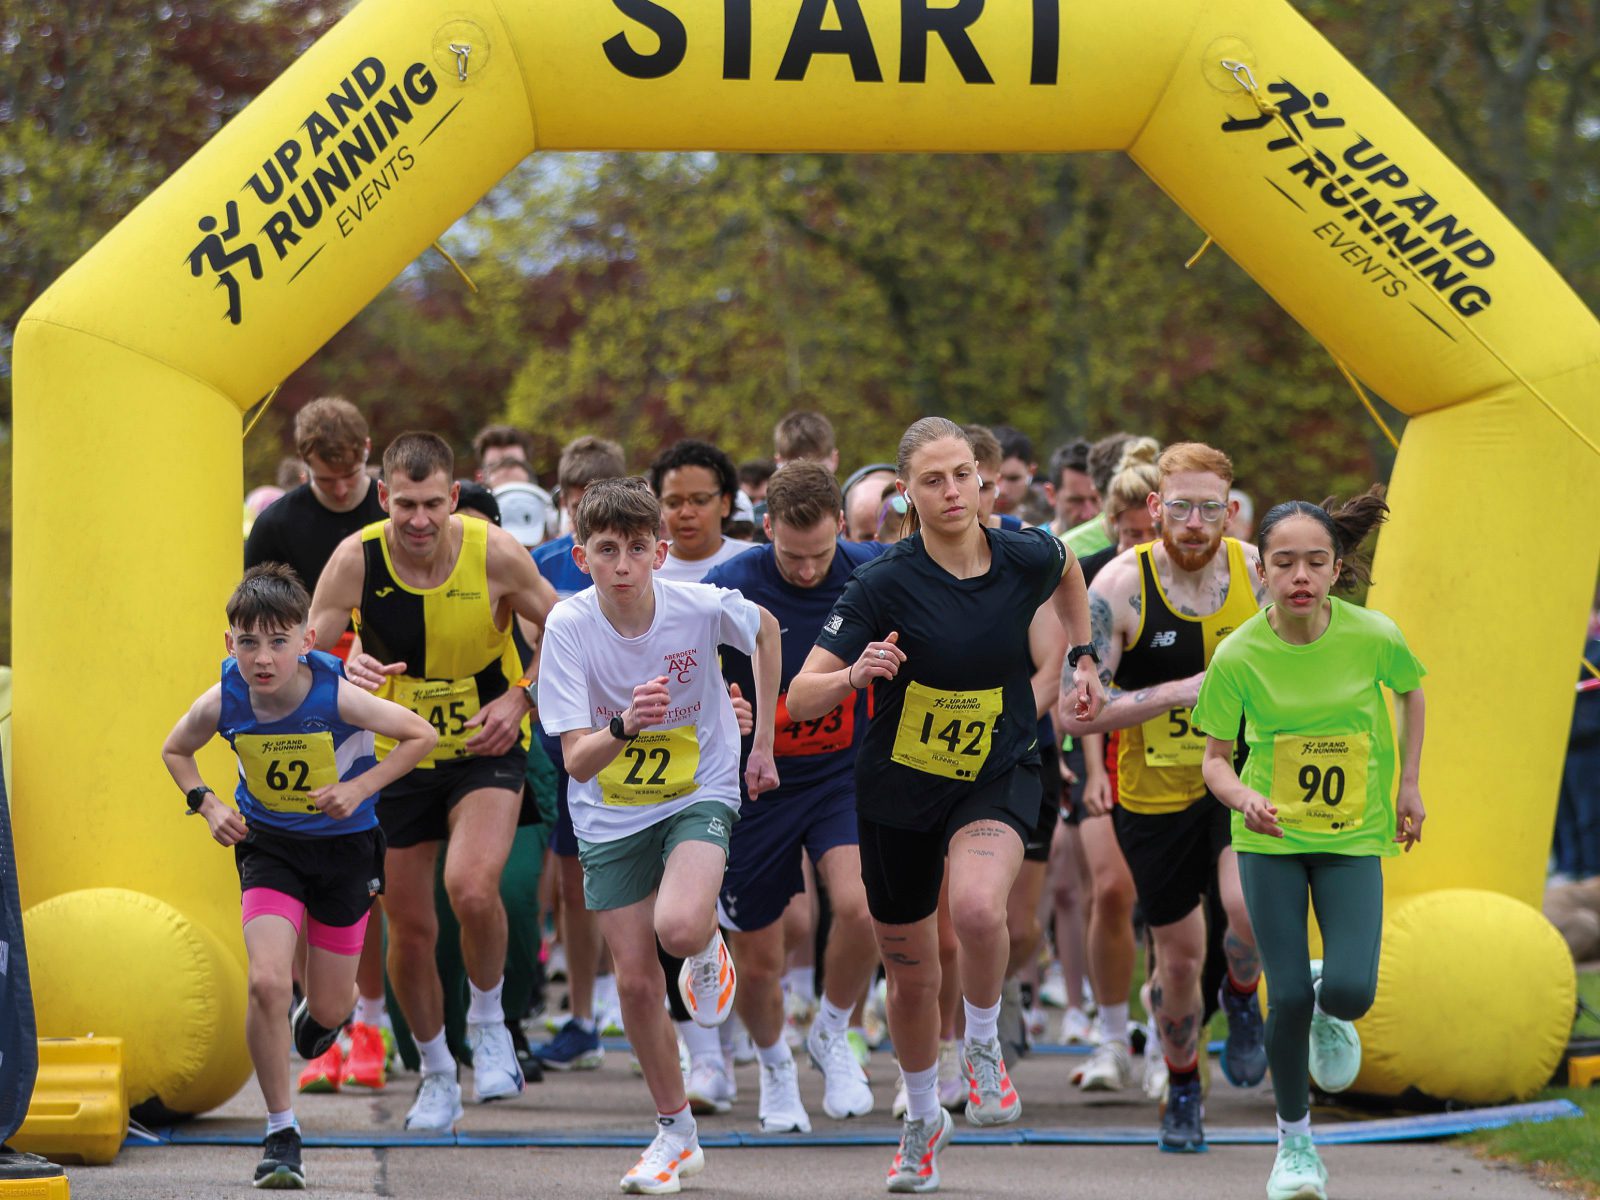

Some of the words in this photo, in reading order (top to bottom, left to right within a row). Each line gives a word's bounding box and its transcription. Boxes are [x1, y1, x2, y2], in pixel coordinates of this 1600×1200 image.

[244, 139, 302, 205] UP
[300, 57, 386, 158] AND
[260, 62, 438, 261] RUNNING
[335, 145, 415, 238] EVENTS
[1343, 136, 1409, 189] UP
[1393, 189, 1495, 268] AND
[1287, 148, 1492, 318] RUNNING
[1312, 221, 1408, 298] EVENTS
[663, 648, 697, 661] ABERDEEN
[410, 701, 469, 737] 45
[920, 712, 986, 756] 142
[266, 760, 311, 792] 62
[622, 747, 671, 785] 22
[1298, 764, 1346, 807] 90
